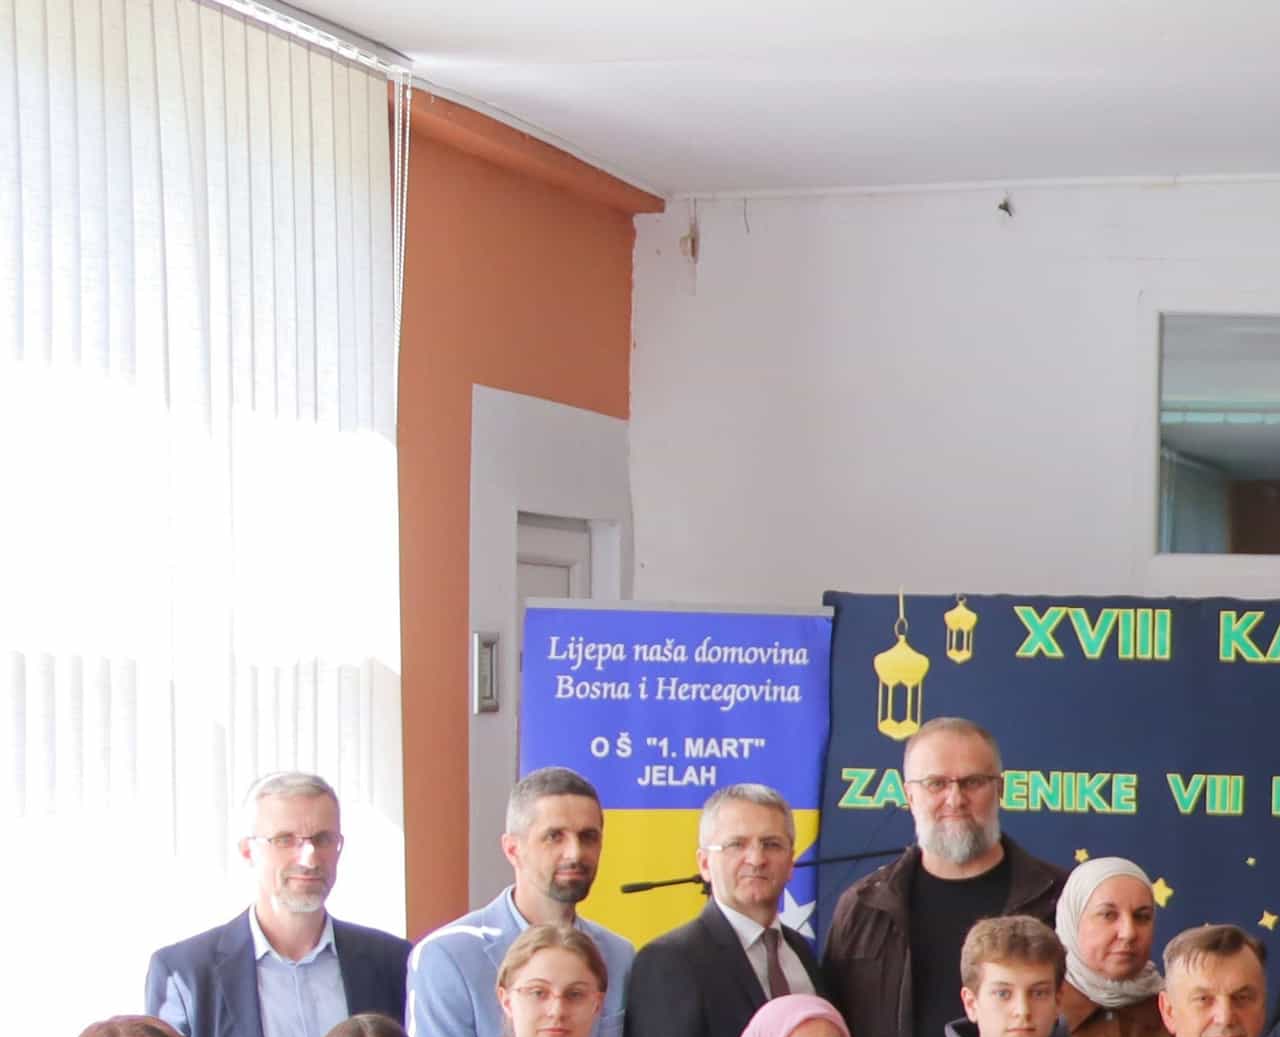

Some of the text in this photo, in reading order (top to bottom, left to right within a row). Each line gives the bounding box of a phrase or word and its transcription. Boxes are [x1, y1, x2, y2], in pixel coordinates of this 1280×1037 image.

[1015, 605, 1173, 662] XVIII
[548, 636, 809, 670] Lijepa naša domovina
[555, 675, 802, 711] Bosna i Hercegovina
[684, 738, 765, 759] MART"
[637, 765, 717, 786] JELAH
[838, 767, 908, 809] ZA
[1000, 769, 1139, 814] ENIKE
[1168, 774, 1245, 817] VIII
